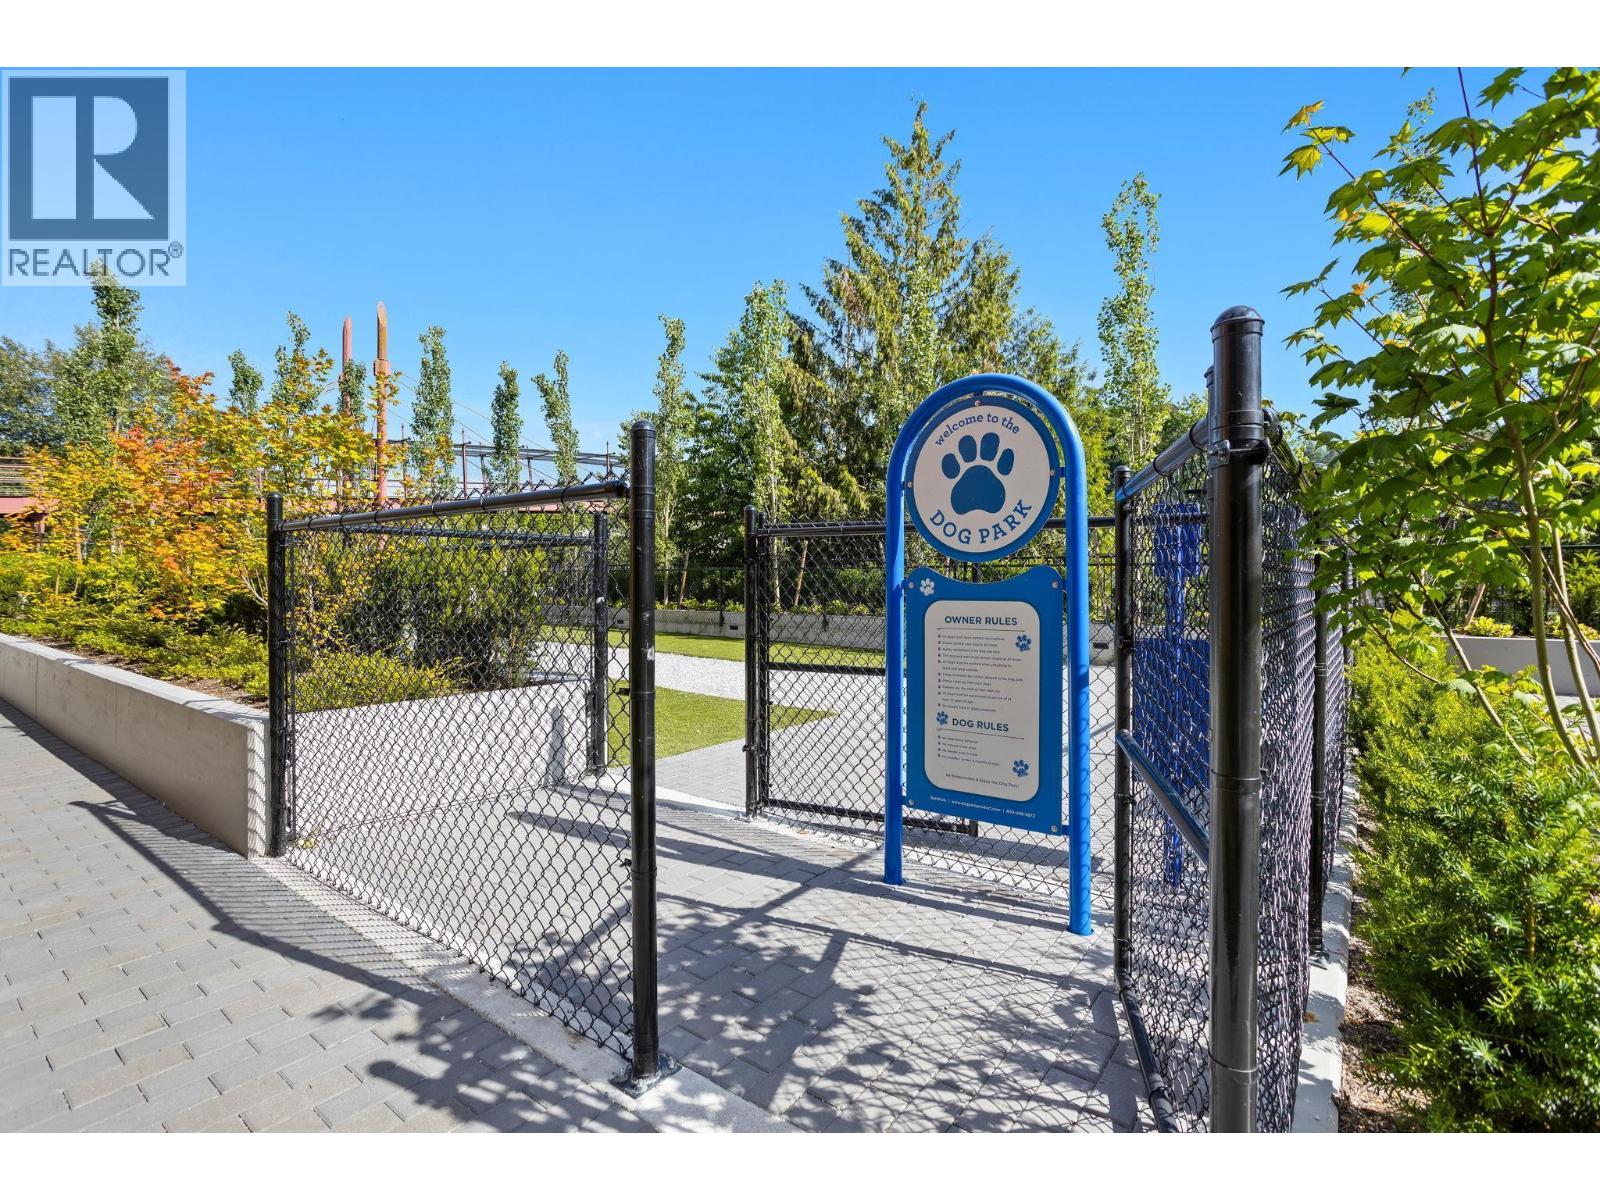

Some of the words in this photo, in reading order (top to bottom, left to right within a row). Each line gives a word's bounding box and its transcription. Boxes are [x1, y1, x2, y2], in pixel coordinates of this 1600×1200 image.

[935, 413, 984, 447] welcome
[986, 412, 999, 424] to
[1001, 416, 1020, 434] the
[930, 509, 972, 545] DOG
[978, 499, 1032, 544] PARK
[944, 615, 982, 625] OWNER
[985, 616, 1018, 626] RULES
[952, 718, 974, 729] DOG
[976, 720, 1009, 732] RULES
